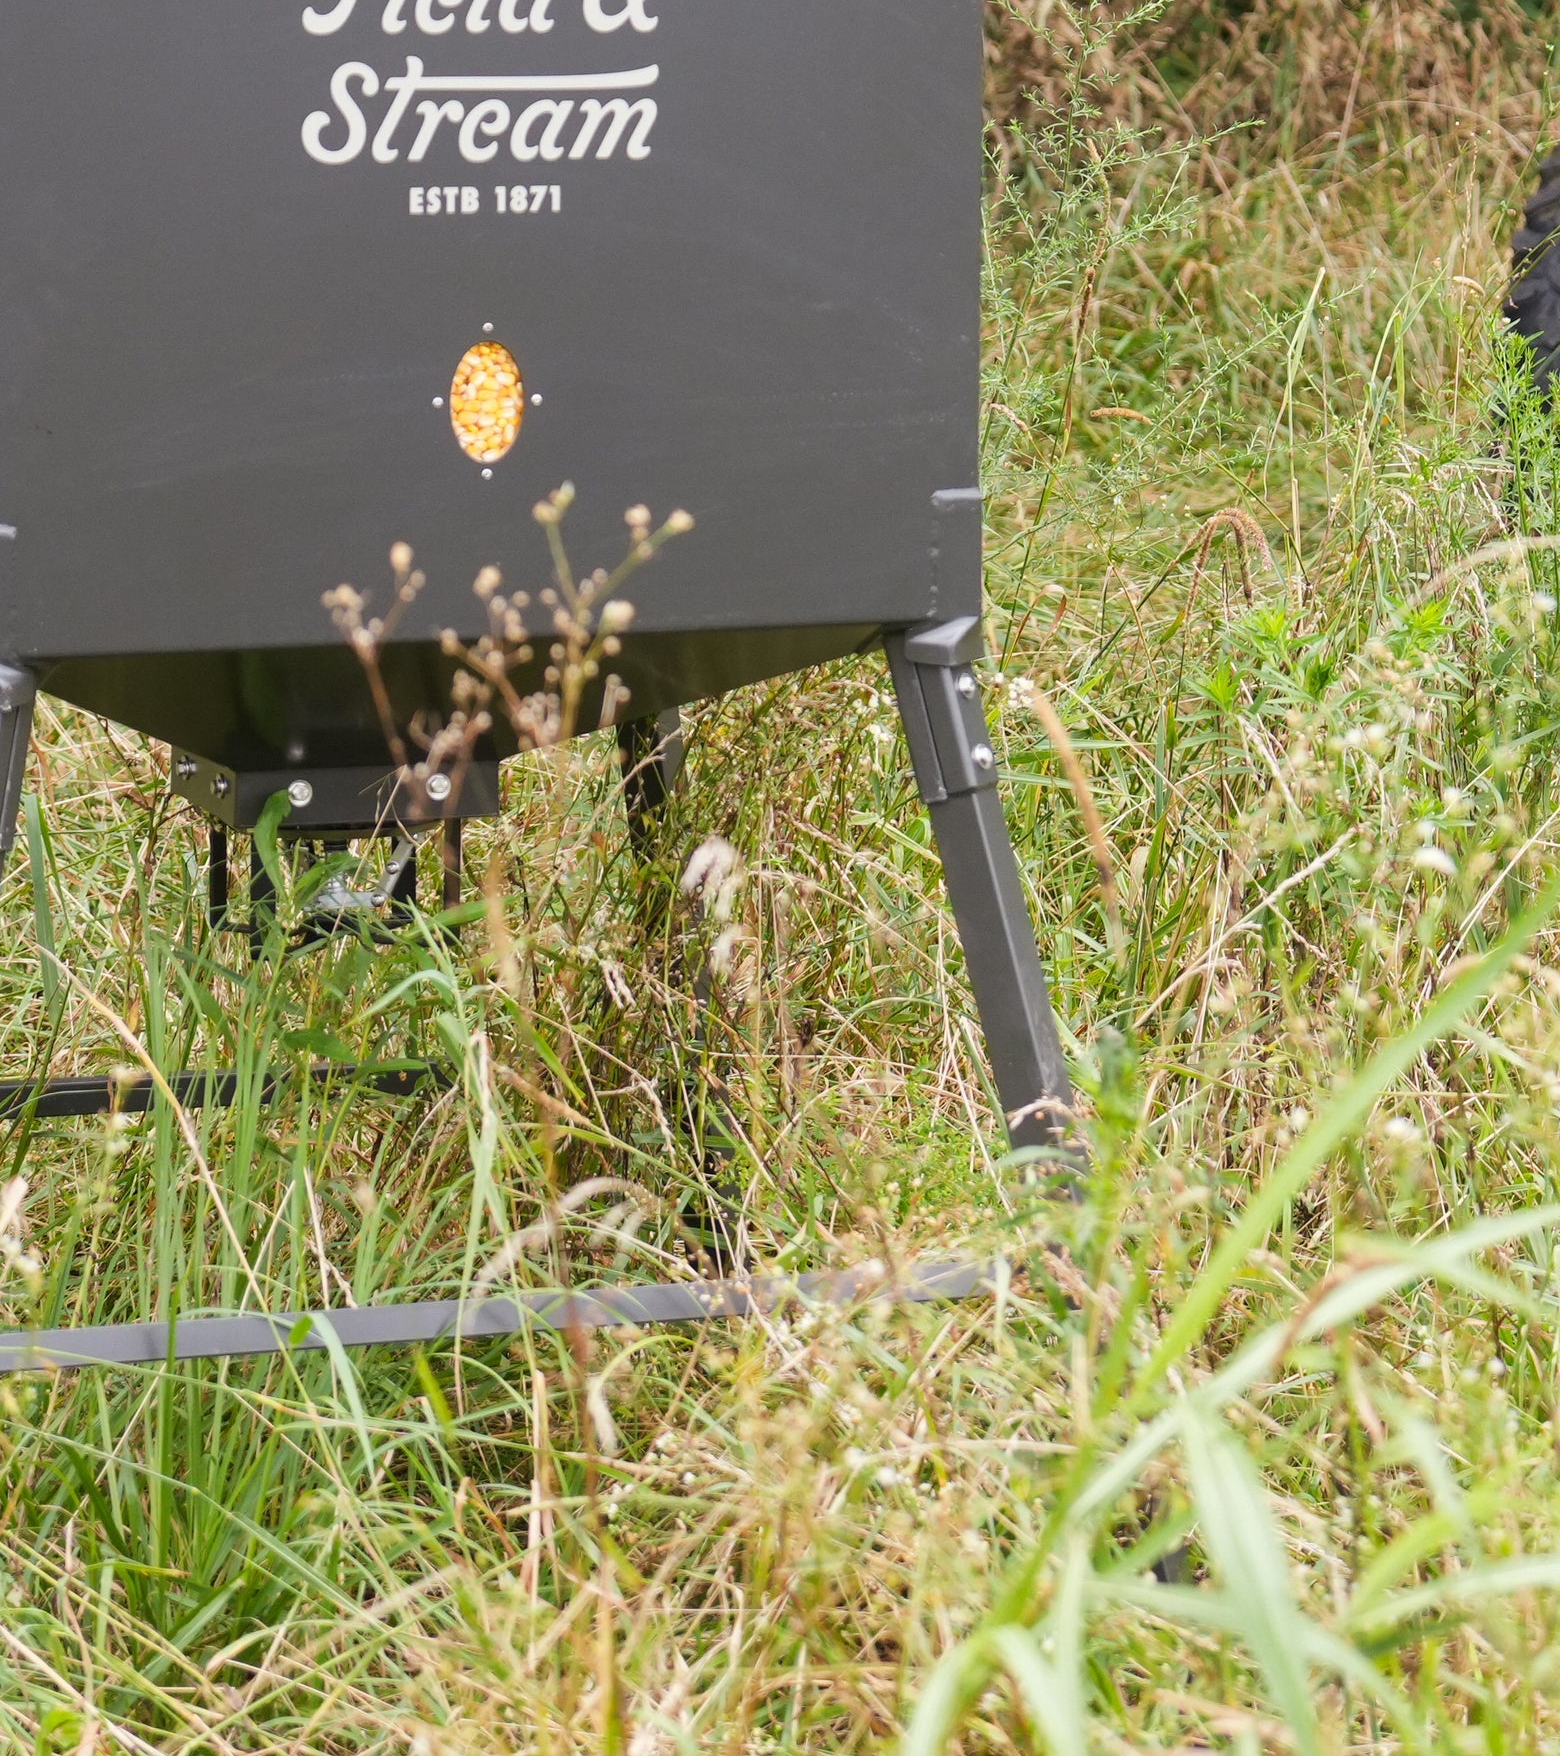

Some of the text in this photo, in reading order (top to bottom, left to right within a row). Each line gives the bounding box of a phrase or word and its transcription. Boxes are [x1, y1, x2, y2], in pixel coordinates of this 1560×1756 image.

[301, 55, 660, 165] Stream
[408, 185, 562, 215] ESTB 1871
